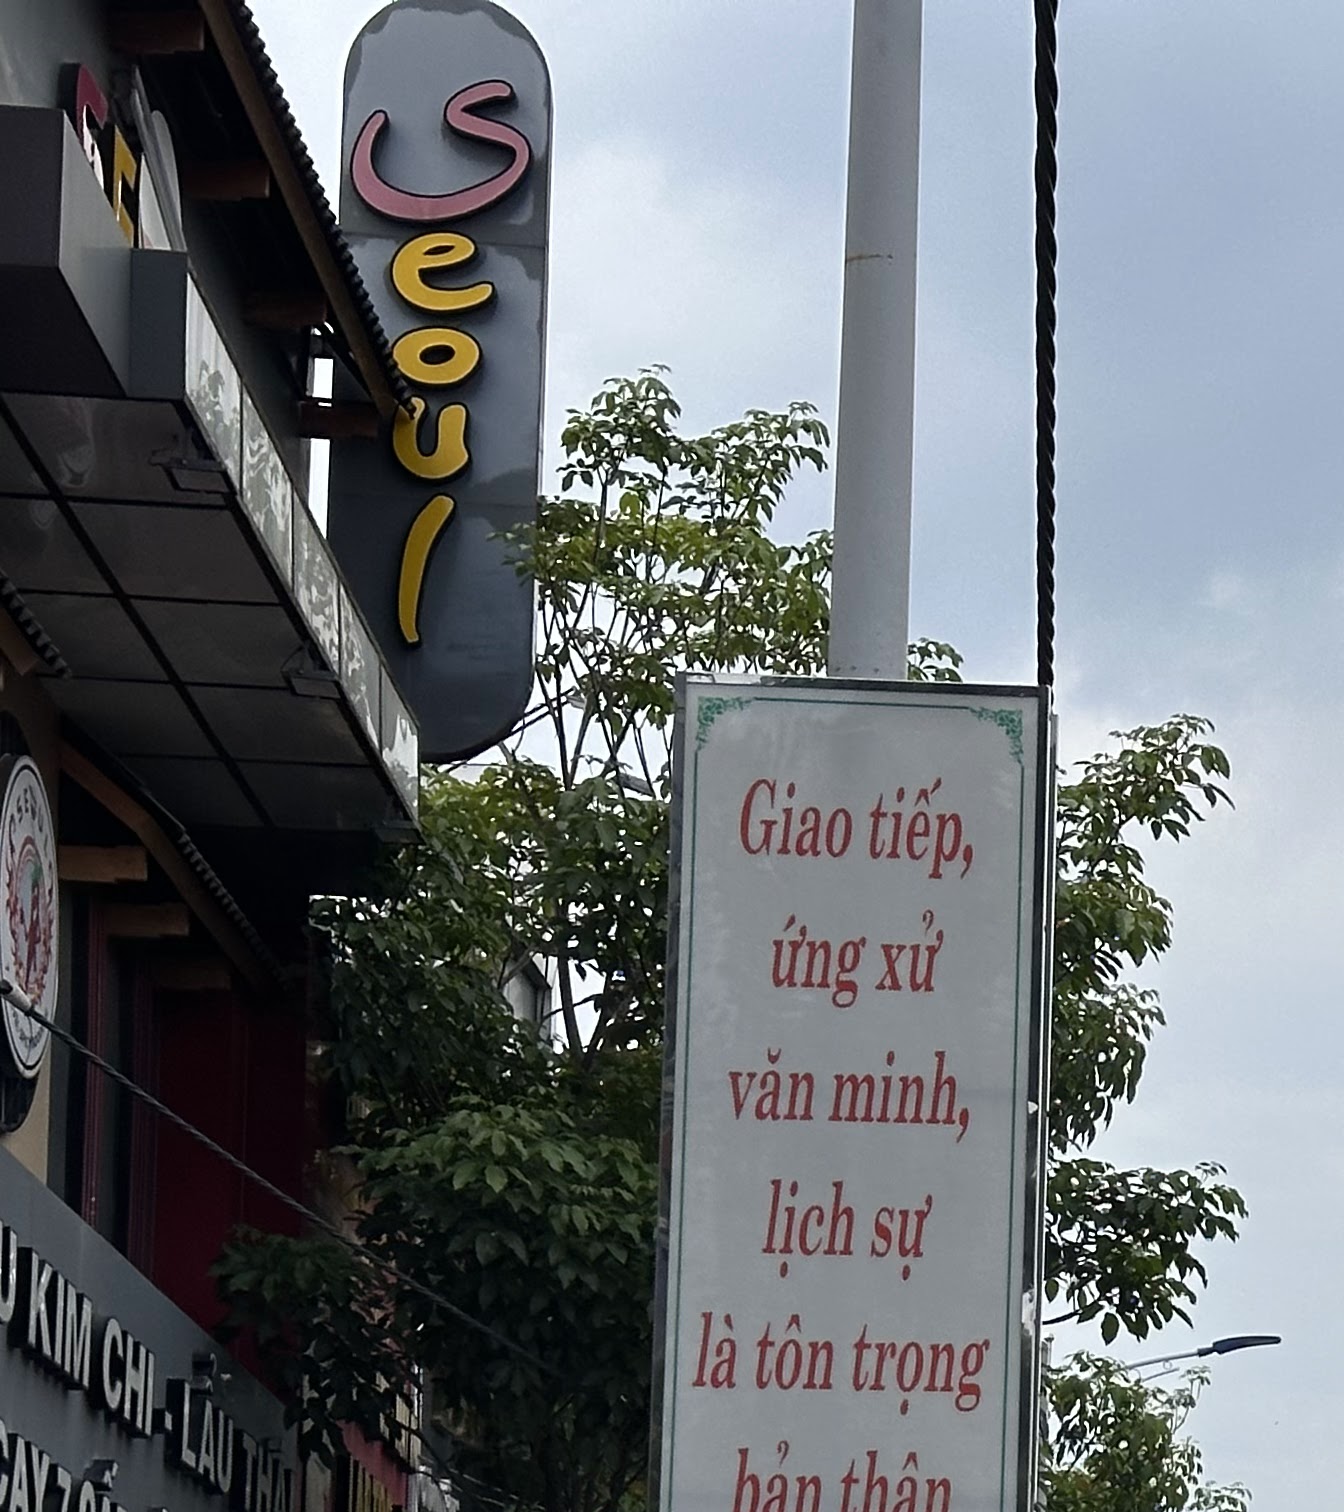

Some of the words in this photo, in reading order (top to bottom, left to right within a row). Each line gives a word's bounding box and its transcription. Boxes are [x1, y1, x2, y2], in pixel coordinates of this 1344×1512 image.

[739, 777, 853, 858] Giao
[868, 777, 975, 881] tiếp,
[771, 913, 865, 1009] ứng
[874, 909, 944, 993] xử
[727, 1046, 813, 1122] văn
[827, 1049, 971, 1143] minh,
[761, 1179, 854, 1279] lịch
[871, 1192, 932, 1281] sự
[28, 1249, 93, 1391] KIM
[102, 1317, 155, 1437] CHI
[691, 1311, 736, 1390] là
[756, 1314, 835, 1390] tôn
[852, 1322, 990, 1416] trọng
